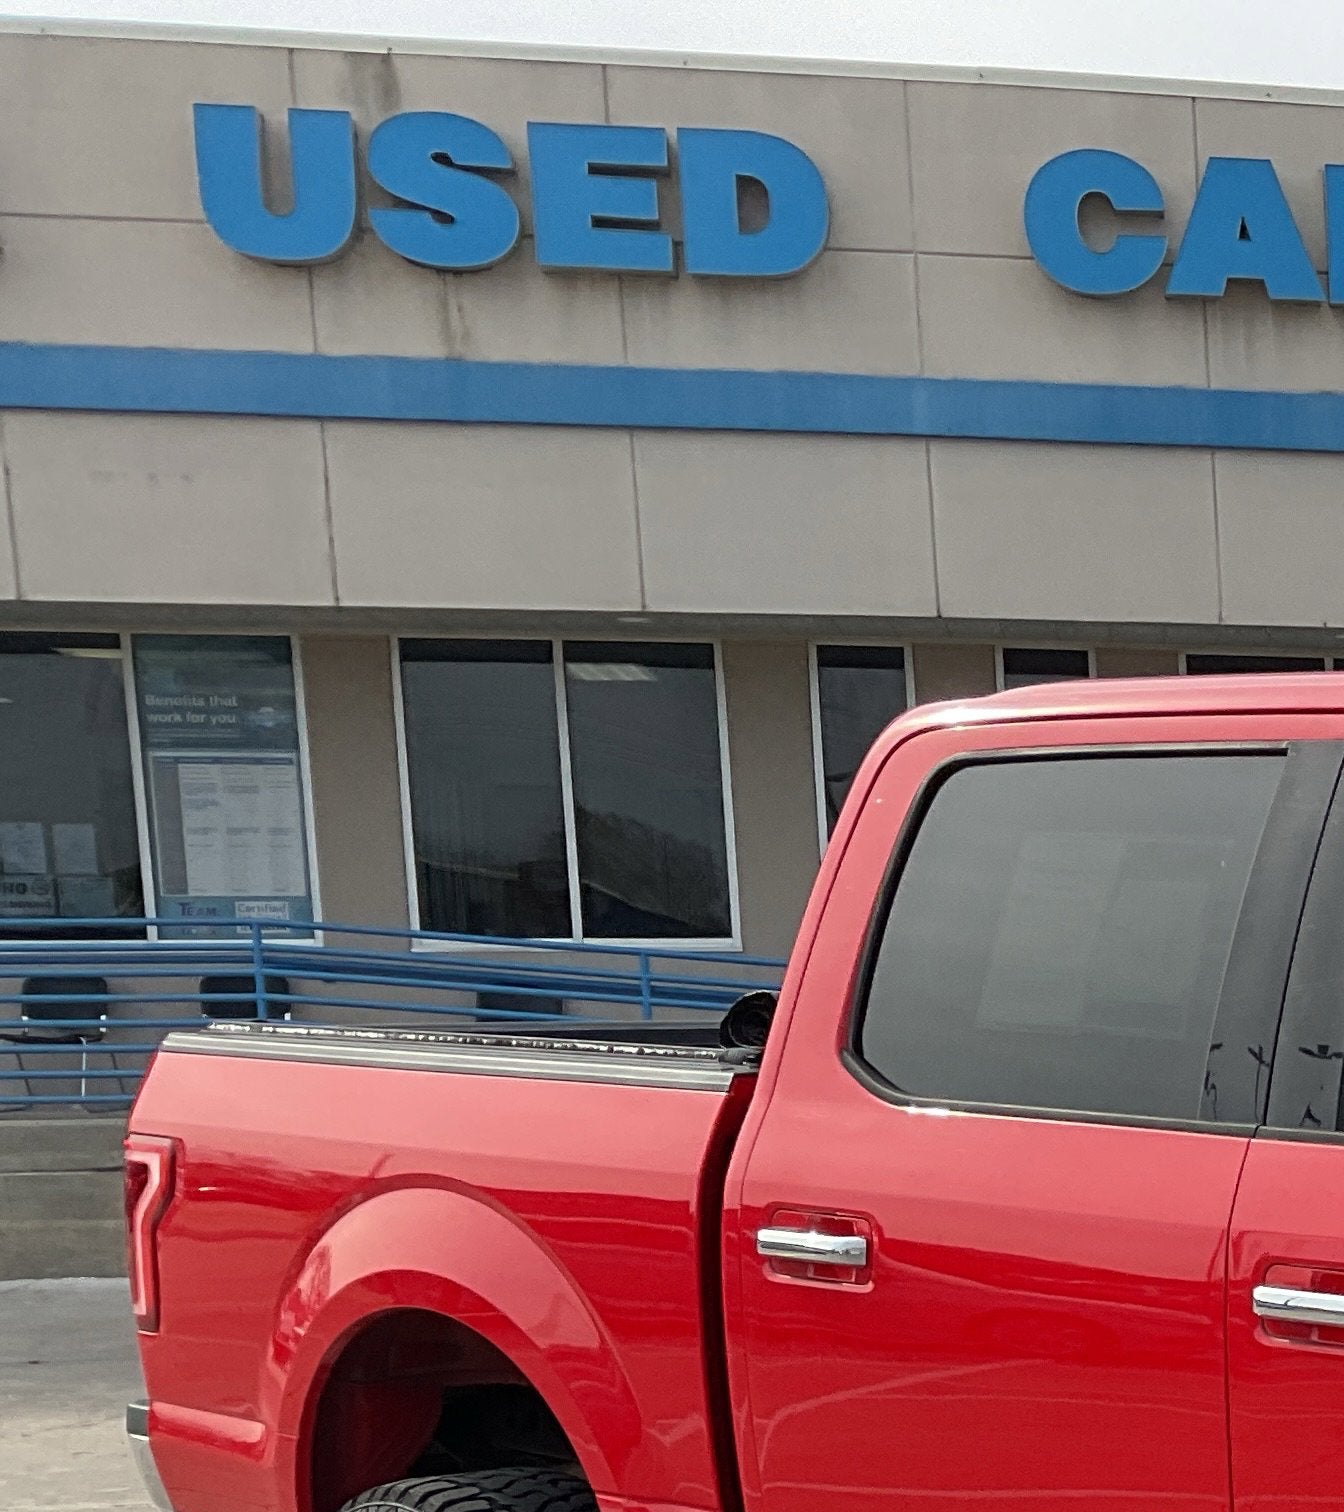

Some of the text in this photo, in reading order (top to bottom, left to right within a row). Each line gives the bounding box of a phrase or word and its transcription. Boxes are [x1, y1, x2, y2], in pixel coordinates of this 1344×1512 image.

[192, 102, 832, 280] USED
[146, 711, 237, 726] work for you
